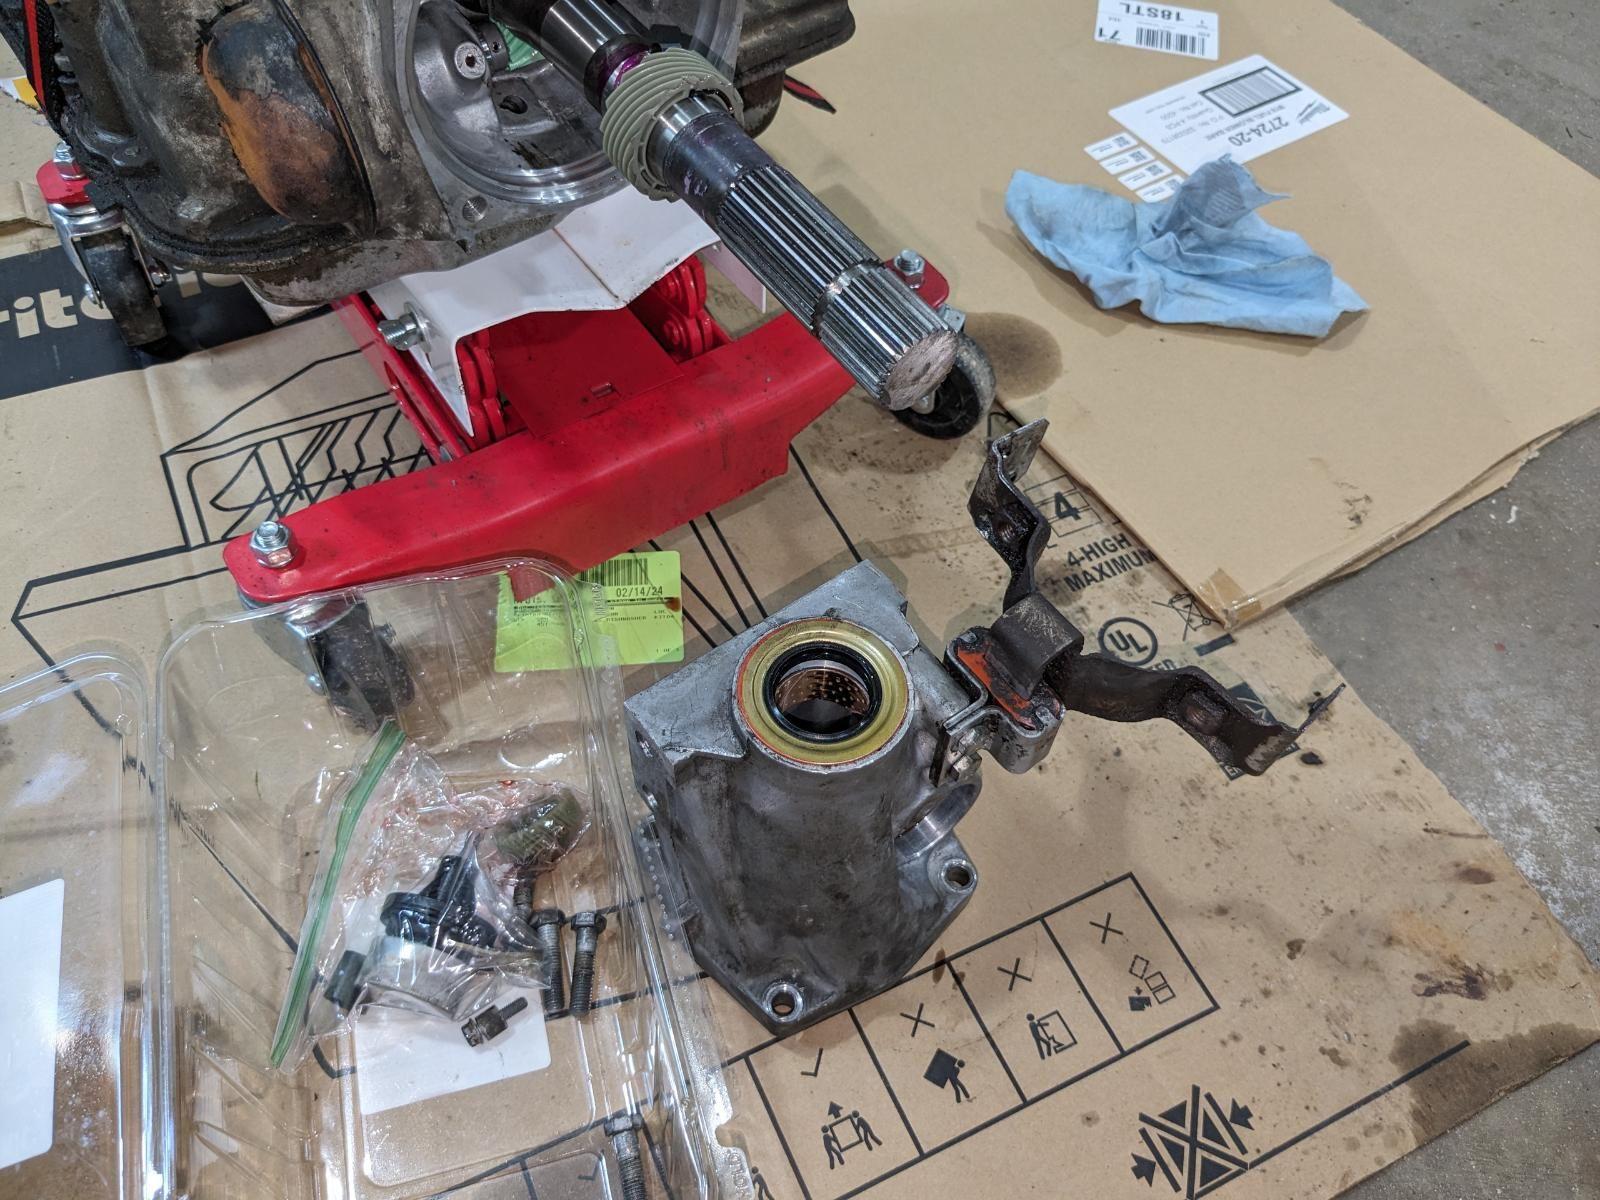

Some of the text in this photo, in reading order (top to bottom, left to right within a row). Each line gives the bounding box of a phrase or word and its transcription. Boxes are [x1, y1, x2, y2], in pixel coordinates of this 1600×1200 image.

[1120, 2, 1184, 21] 18STL
[1098, 27, 1121, 41] 71
[1228, 116, 1289, 147] 2724-20
[1053, 491, 1082, 522] 4
[1067, 533, 1132, 567] 4-HIGH
[1063, 549, 1159, 592] MAXIMUM
[616, 585, 663, 598] 02/14/24
[1107, 629, 1149, 653] UL
